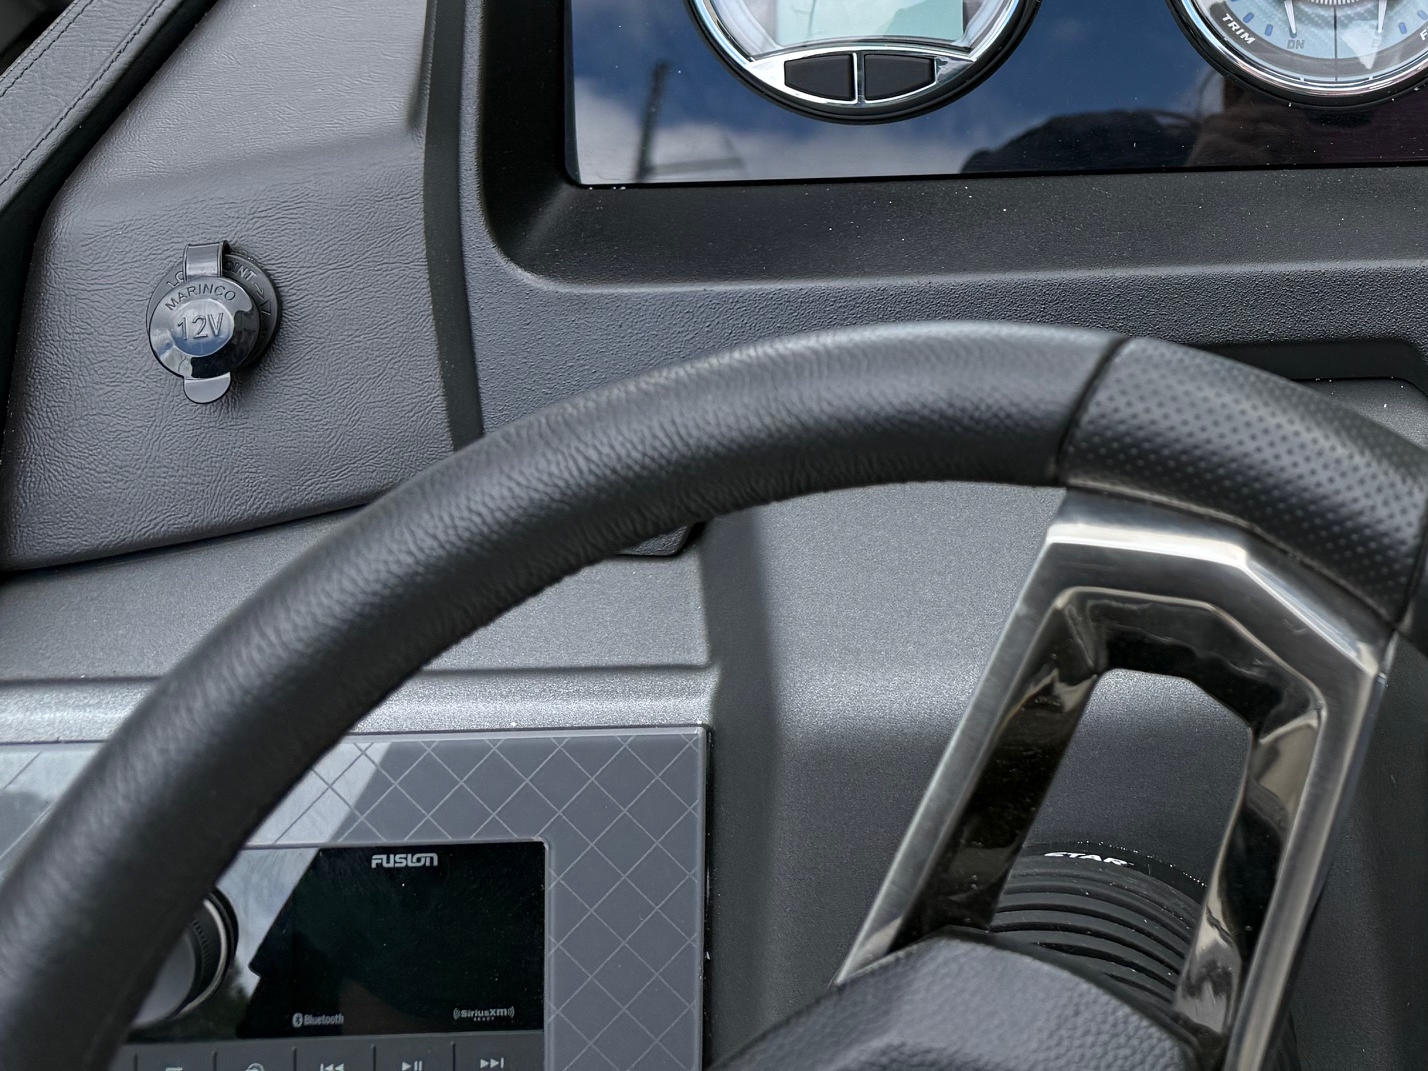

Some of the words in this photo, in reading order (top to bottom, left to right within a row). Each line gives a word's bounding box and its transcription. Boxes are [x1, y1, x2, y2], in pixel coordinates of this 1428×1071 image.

[1222, 13, 1256, 45] TRIM
[1287, 39, 1305, 49] DN
[164, 283, 237, 311] MARINCO
[177, 312, 224, 341] 12V
[371, 852, 438, 869] FUSION
[303, 1013, 344, 1026] Bluetooth
